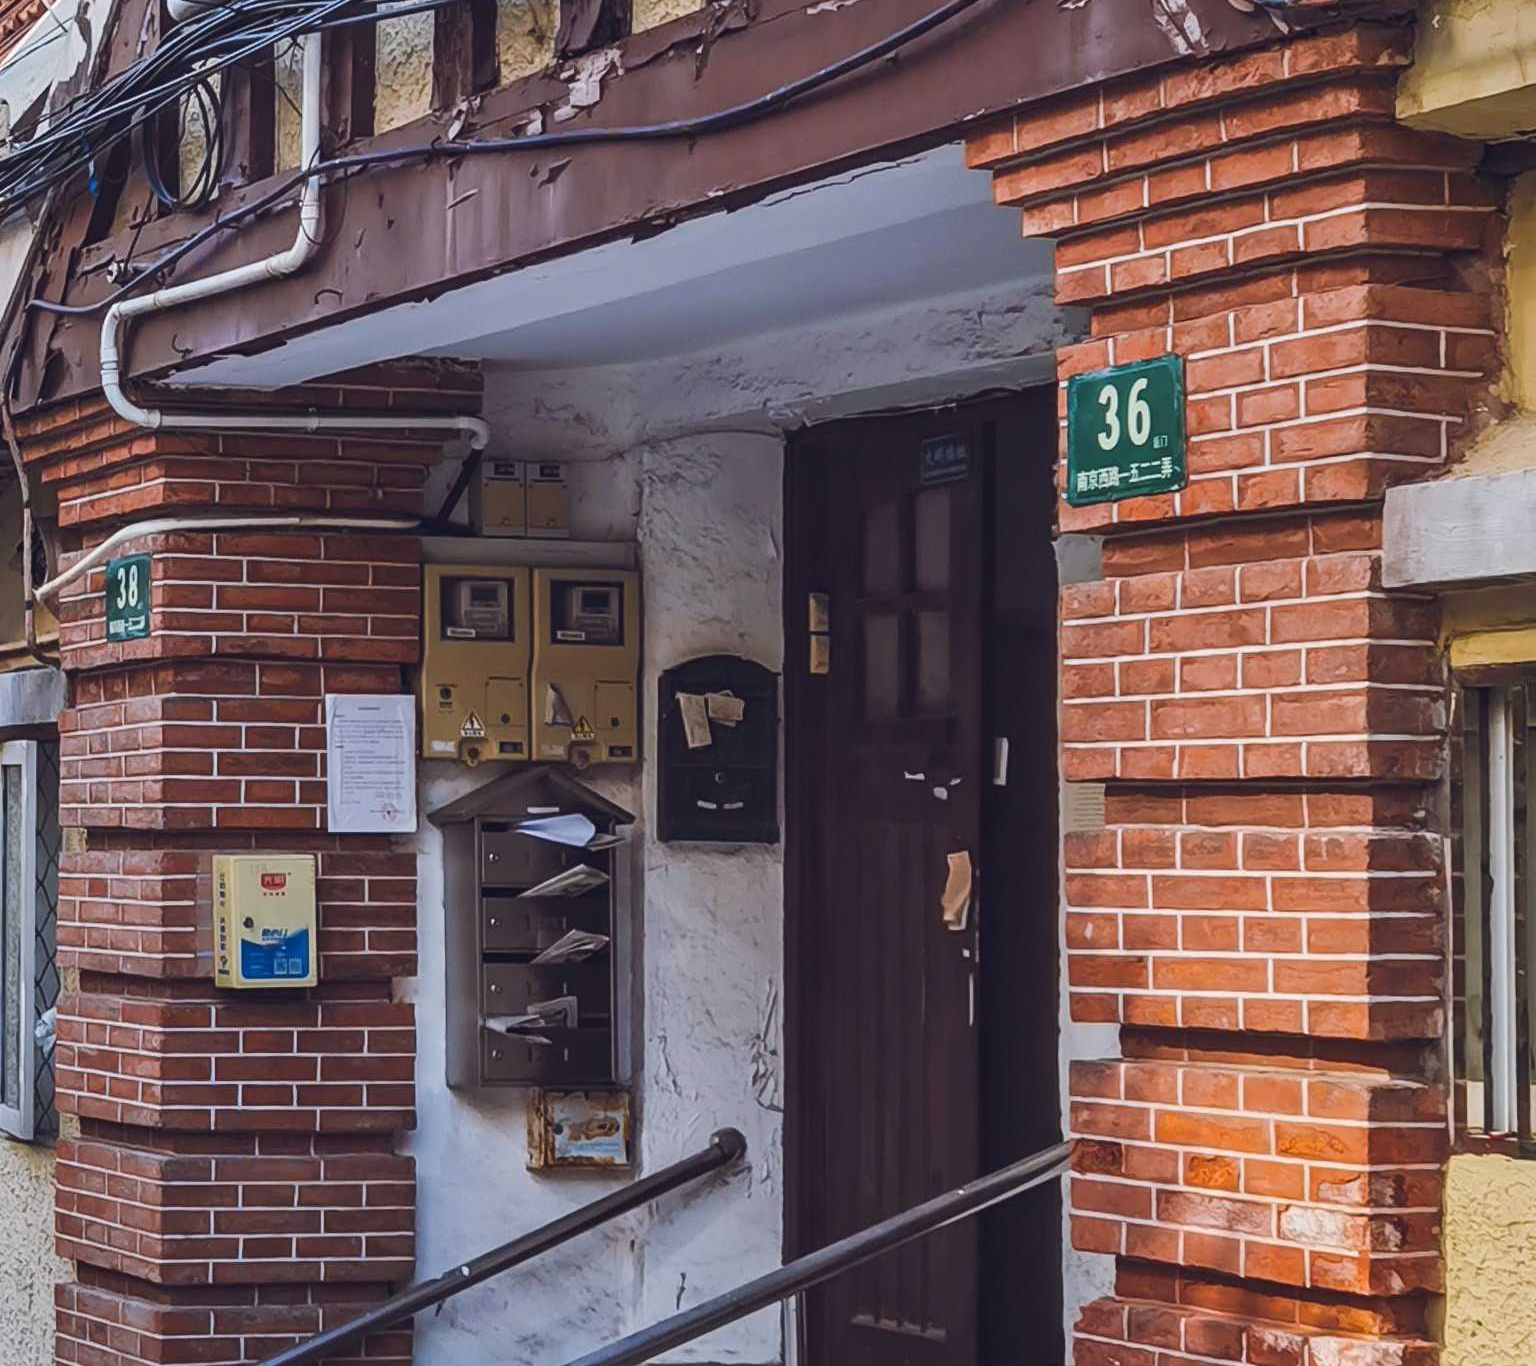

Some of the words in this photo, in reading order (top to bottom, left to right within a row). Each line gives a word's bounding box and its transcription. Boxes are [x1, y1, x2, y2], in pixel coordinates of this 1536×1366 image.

[1097, 378, 1151, 450] 36
[1076, 456, 1174, 492] 南京西路一五二二弄
[116, 564, 139, 610] 38
